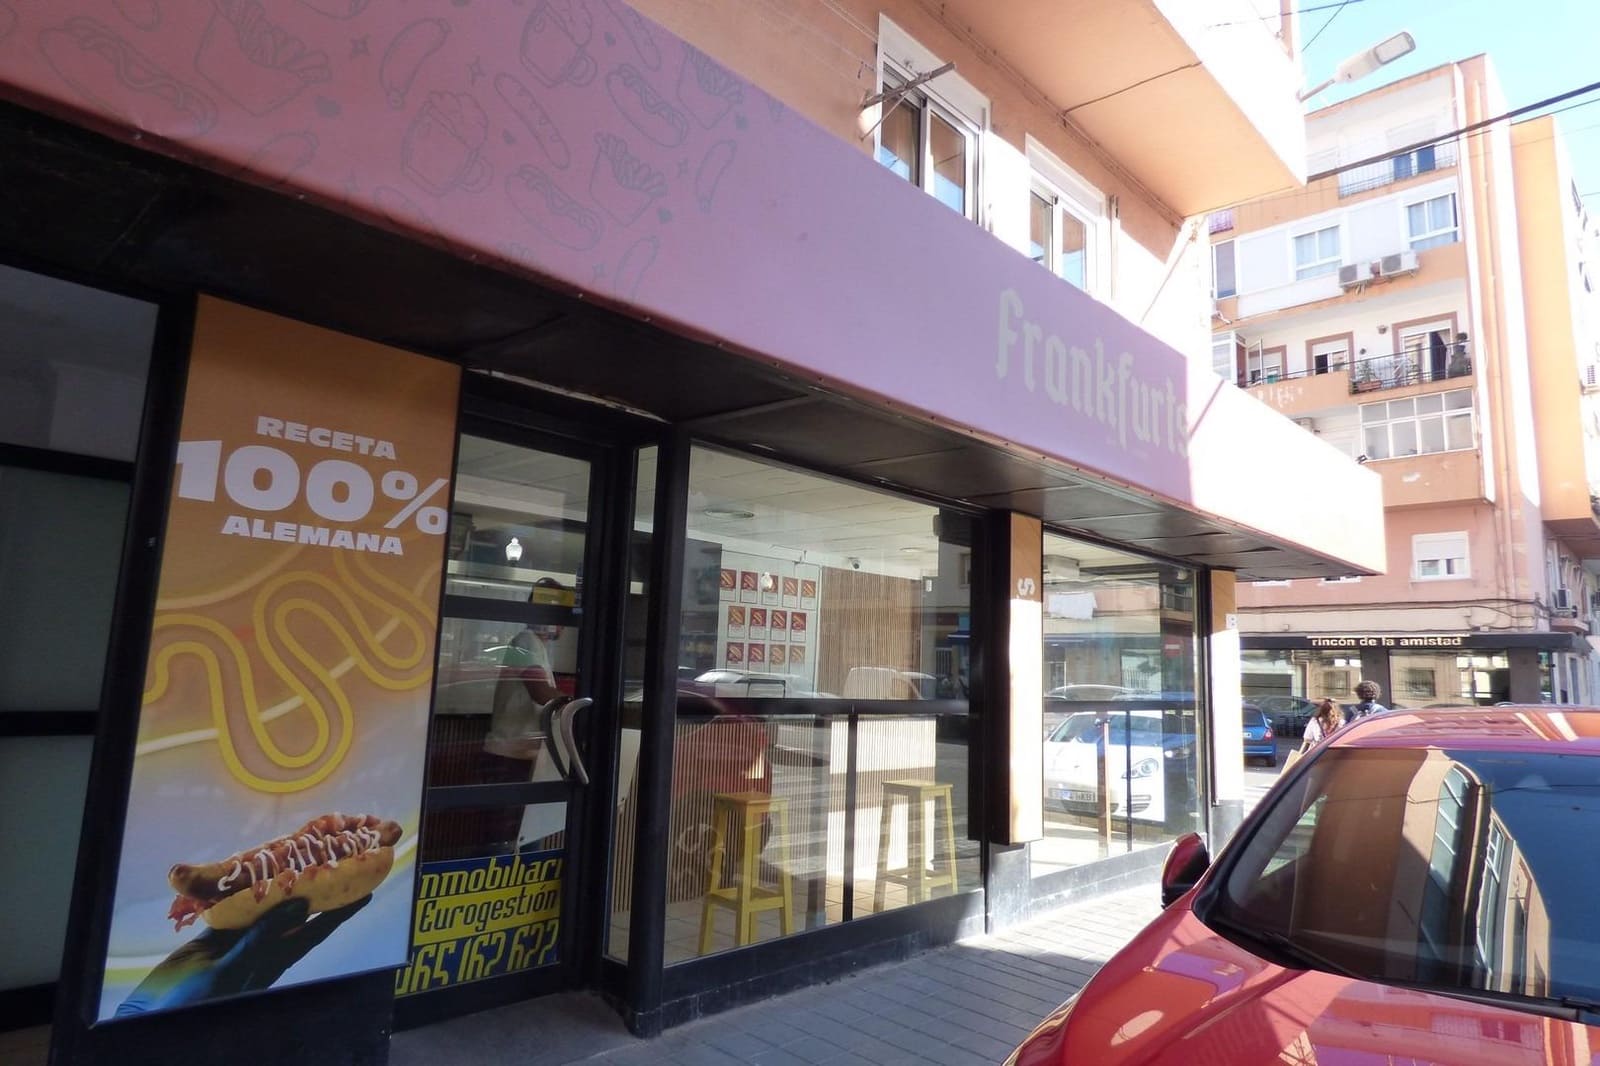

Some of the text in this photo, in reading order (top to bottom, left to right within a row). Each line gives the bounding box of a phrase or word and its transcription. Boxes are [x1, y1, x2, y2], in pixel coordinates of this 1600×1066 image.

[256, 415, 396, 460] RECETA
[176, 440, 449, 535] 100%
[221, 515, 403, 556] ALEMANA
[1359, 636, 1377, 647] de
[1381, 636, 1395, 647] la
[1399, 636, 1462, 647] amistad
[419, 884, 559, 933] Eurogestión
